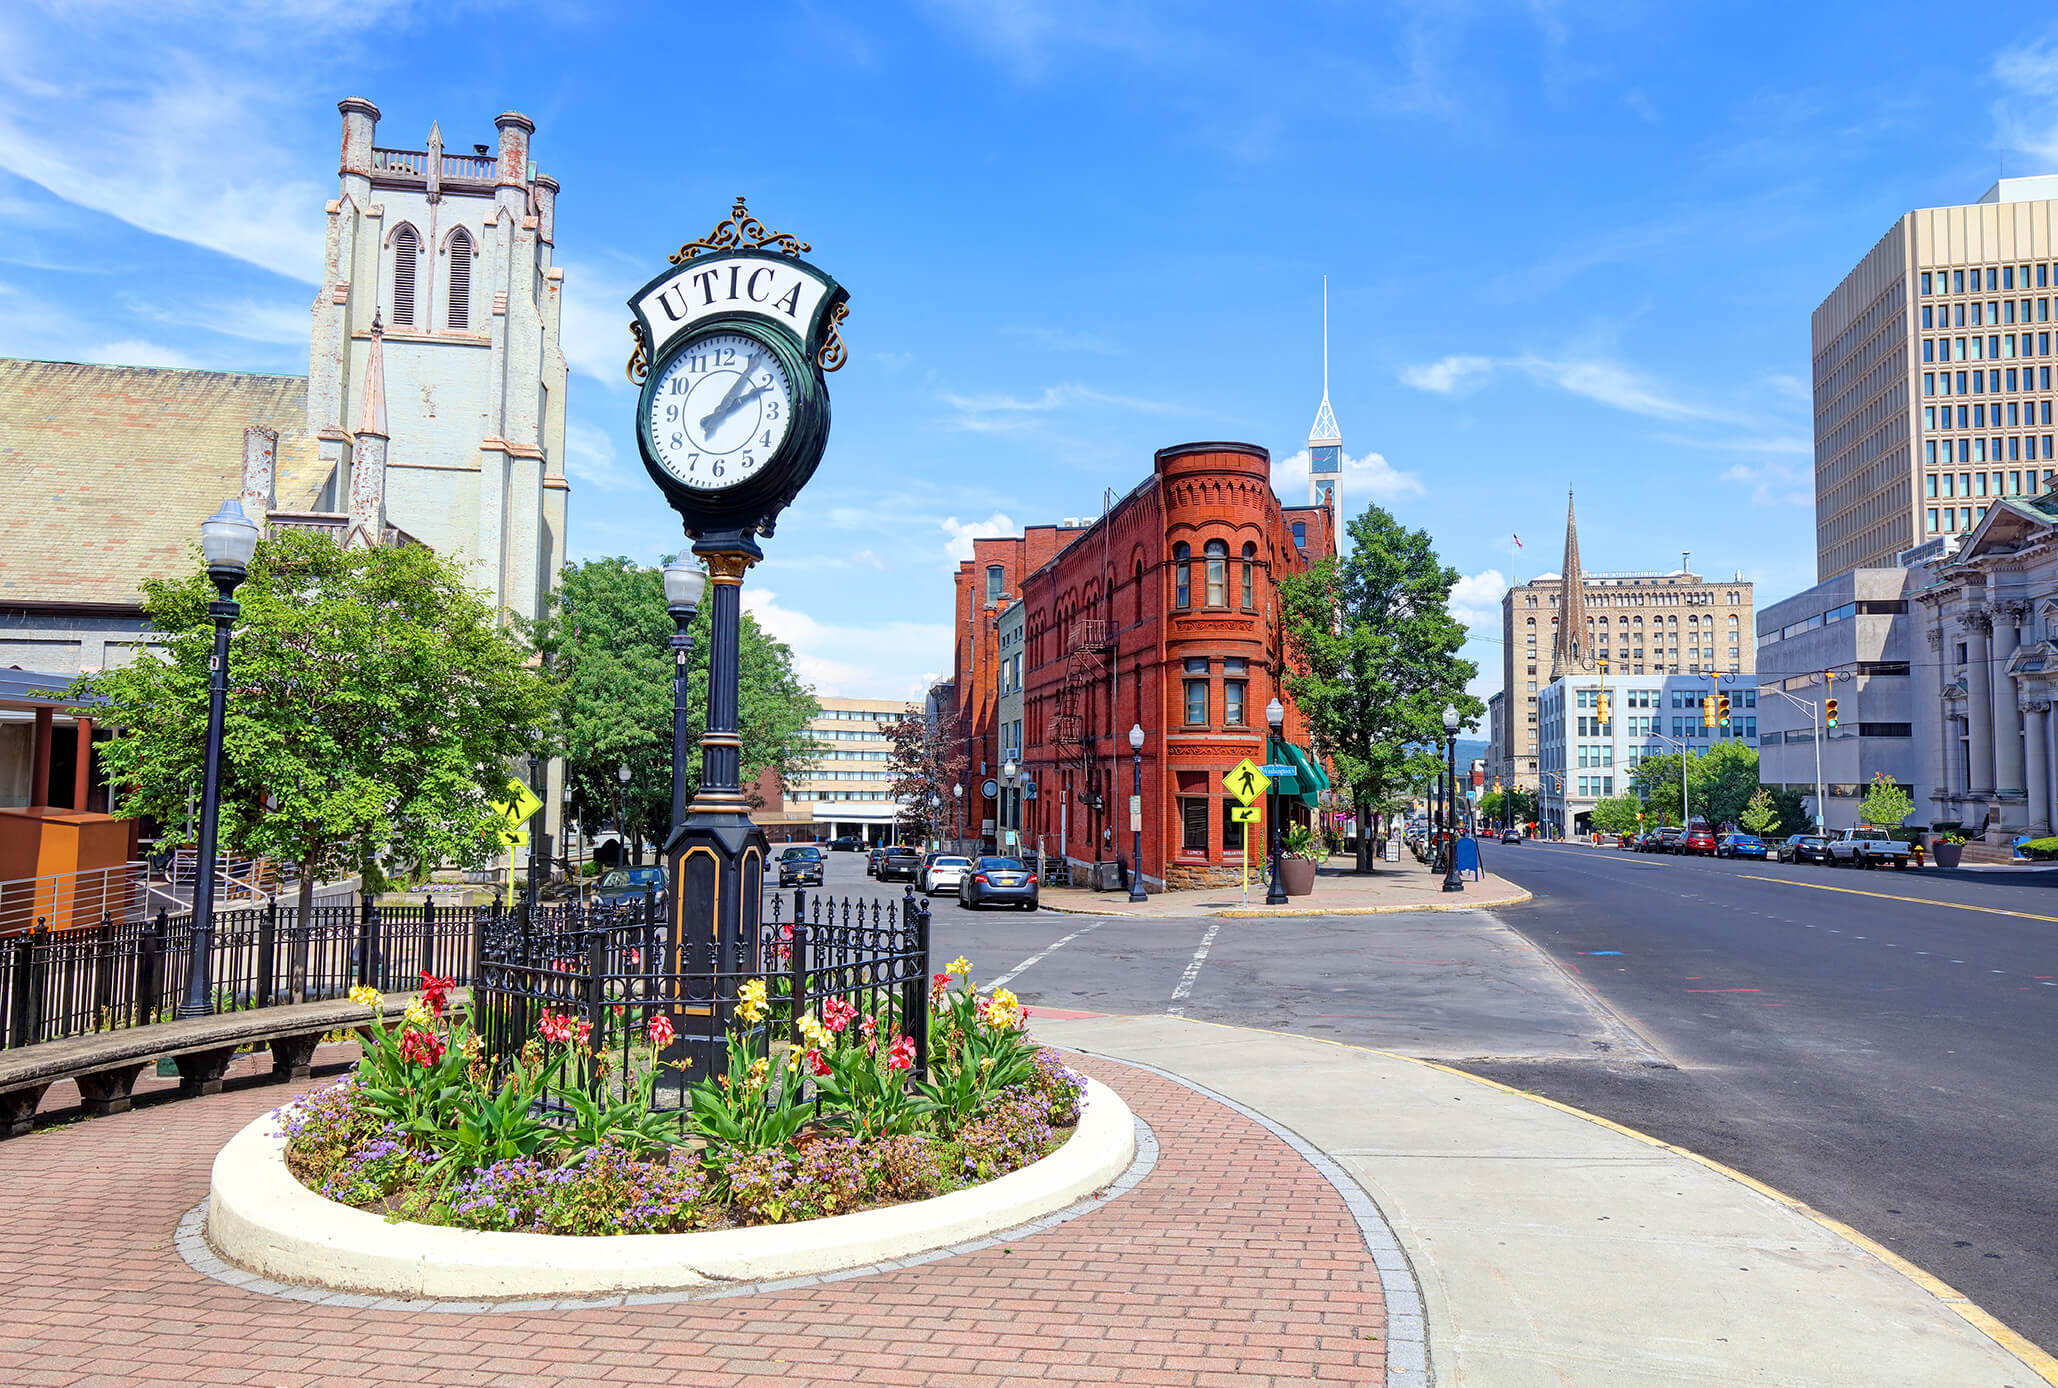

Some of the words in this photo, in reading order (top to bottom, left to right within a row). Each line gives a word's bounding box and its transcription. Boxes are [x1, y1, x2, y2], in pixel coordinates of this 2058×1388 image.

[656, 265, 802, 321] UTICA
[689, 354, 708, 373] 11
[712, 347, 736, 366] 12
[670, 376, 690, 395] 10
[762, 373, 774, 391] 2
[666, 404, 679, 423] 9
[766, 401, 779, 420] 3
[670, 432, 683, 450] 8
[759, 428, 772, 447] 4
[688, 453, 700, 471] 7
[712, 459, 725, 477] 6
[741, 449, 754, 468] 5
